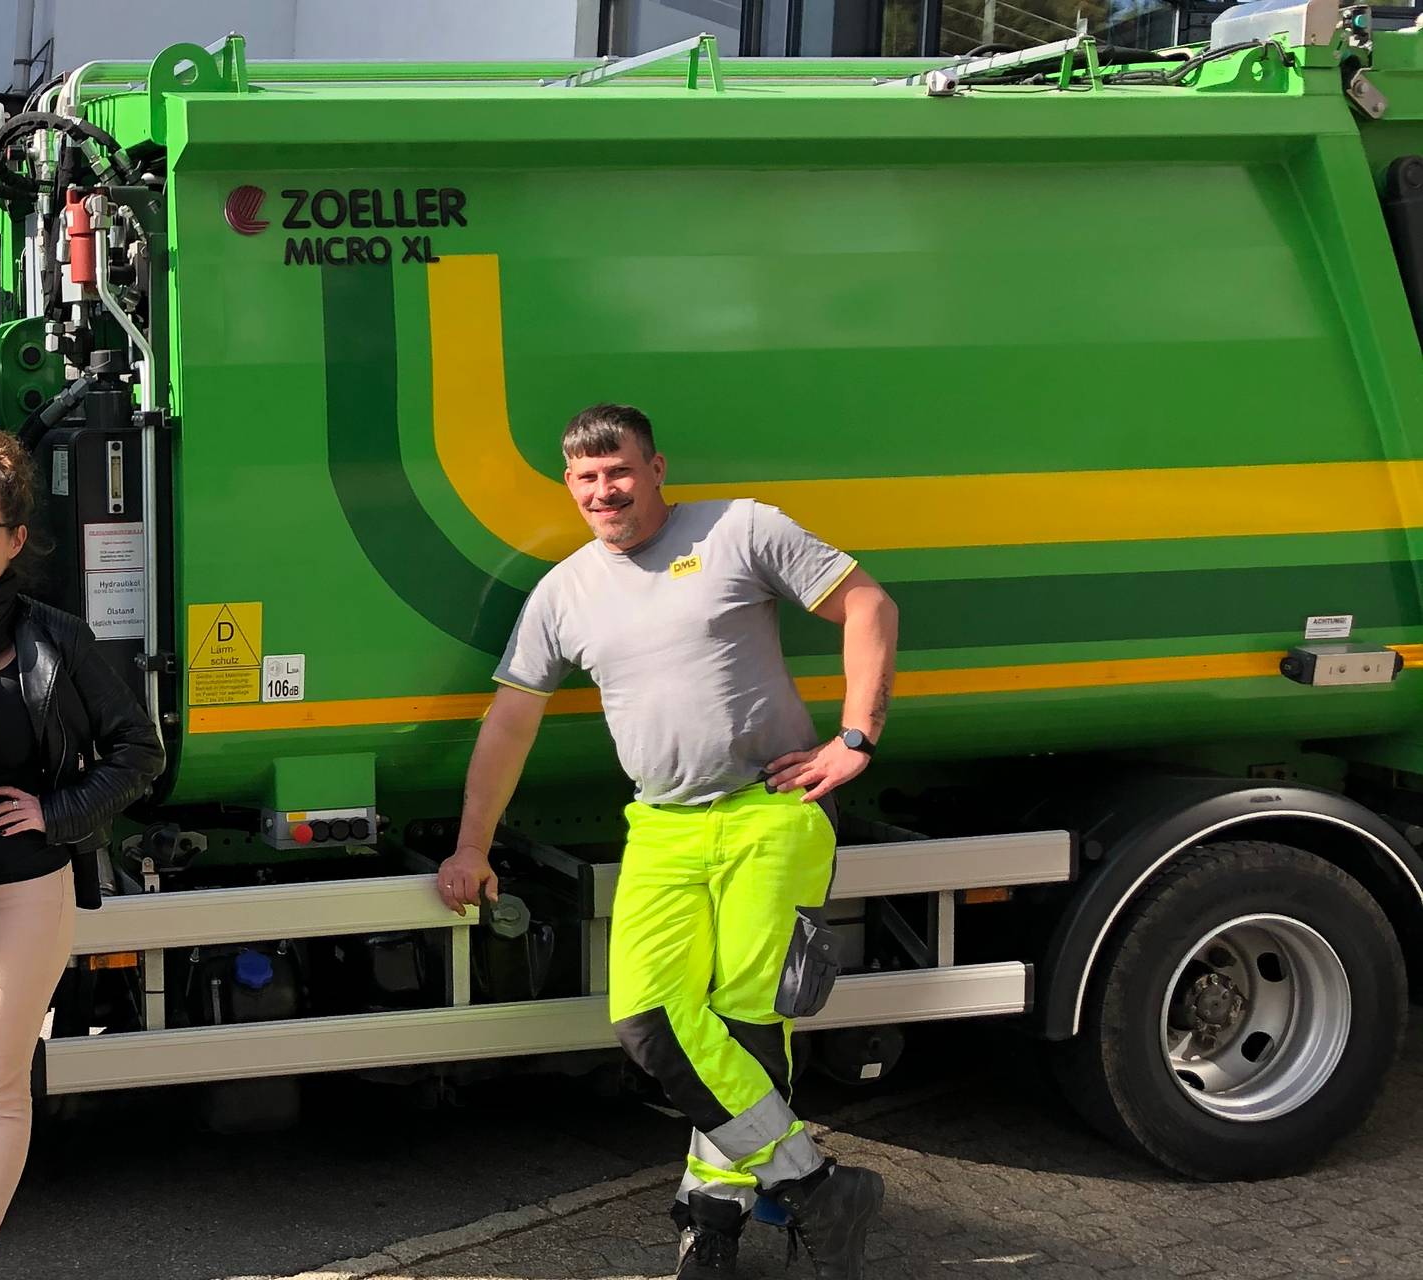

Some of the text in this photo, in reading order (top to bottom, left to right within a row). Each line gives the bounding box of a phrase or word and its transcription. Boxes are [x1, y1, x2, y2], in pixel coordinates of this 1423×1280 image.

[281, 188, 467, 229] ZOELLER
[284, 235, 440, 266] MICRO XL
[217, 621, 234, 642] D
[210, 645, 236, 654] Lärm-
[210, 656, 239, 665] schutz
